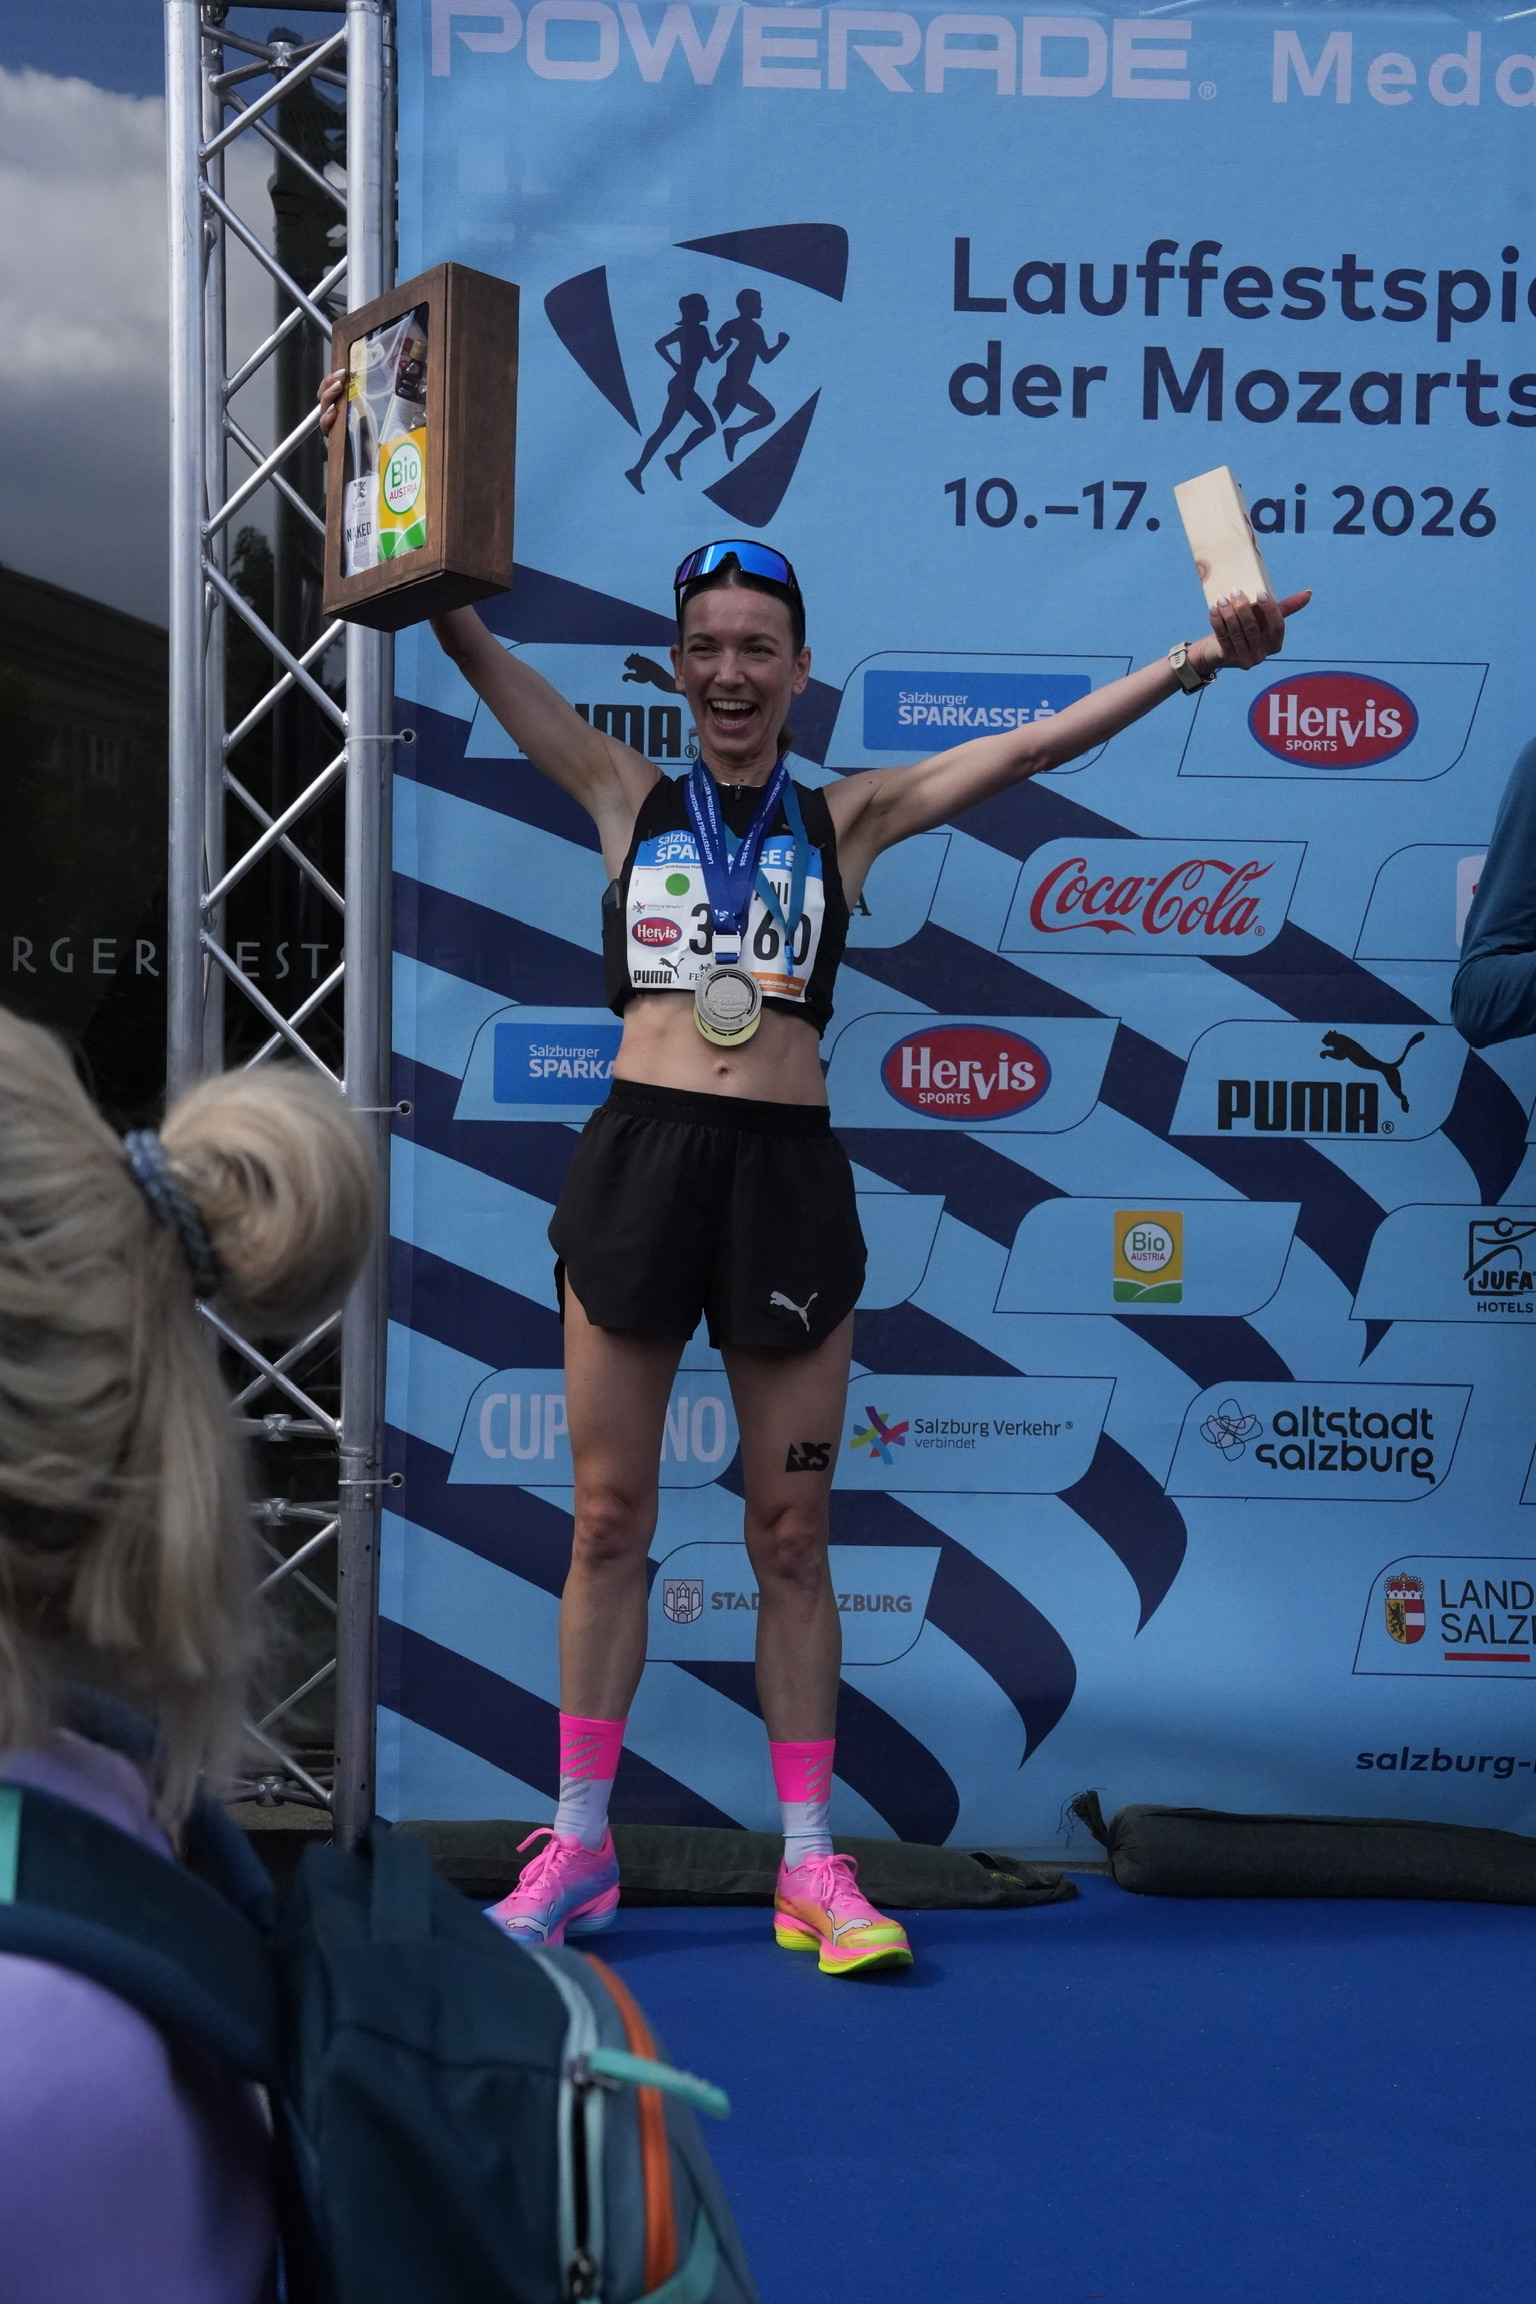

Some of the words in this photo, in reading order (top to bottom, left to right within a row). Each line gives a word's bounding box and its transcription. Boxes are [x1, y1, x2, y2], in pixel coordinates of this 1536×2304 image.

[431, 0, 1192, 100] POWERADE
[948, 341, 1107, 418] der
[1142, 346, 1536, 428] Mozarts
[391, 456, 418, 489] Bio
[389, 483, 418, 501] AUSTRIA
[1239, 483, 1307, 534] ai
[1332, 485, 1497, 537] 2026
[346, 521, 372, 542] NAKED
[898, 692, 969, 706] Salzburger
[898, 705, 1030, 728] SPARKASSE
[1268, 694, 1403, 747] Hervis
[520, 702, 682, 758] MA
[1286, 739, 1338, 751] SPORTS
[657, 832, 696, 847] Salzbu
[1029, 857, 1276, 936] Coca-Cola
[637, 924, 678, 941] Hervis
[236, 941, 346, 980] EST
[633, 970, 673, 984] PUMA
[529, 1044, 600, 1060] Salzburger
[902, 1046, 1036, 1100] Hervis
[918, 1092, 971, 1105] SPORTS
[1217, 1079, 1379, 1134] PUMA
[1132, 1231, 1165, 1252] Bio
[1131, 1252, 1166, 1262] AUSTRIA
[1477, 1269, 1534, 1291] JUFA
[1477, 1301, 1534, 1313] HOTELS
[914, 1418, 989, 1437] Salzburg
[993, 1420, 1061, 1437] Verkehr
[1272, 1405, 1434, 1440] altstadt
[914, 1438, 976, 1450] verbindet
[1255, 1439, 1436, 1484] salzburg
[711, 1592, 760, 1611] STAD
[838, 1594, 912, 1613] ZBURG
[1440, 1579, 1534, 1610] LAND
[1441, 1613, 1536, 1645] SALZ
[1355, 1746, 1536, 1780] salzburg-
